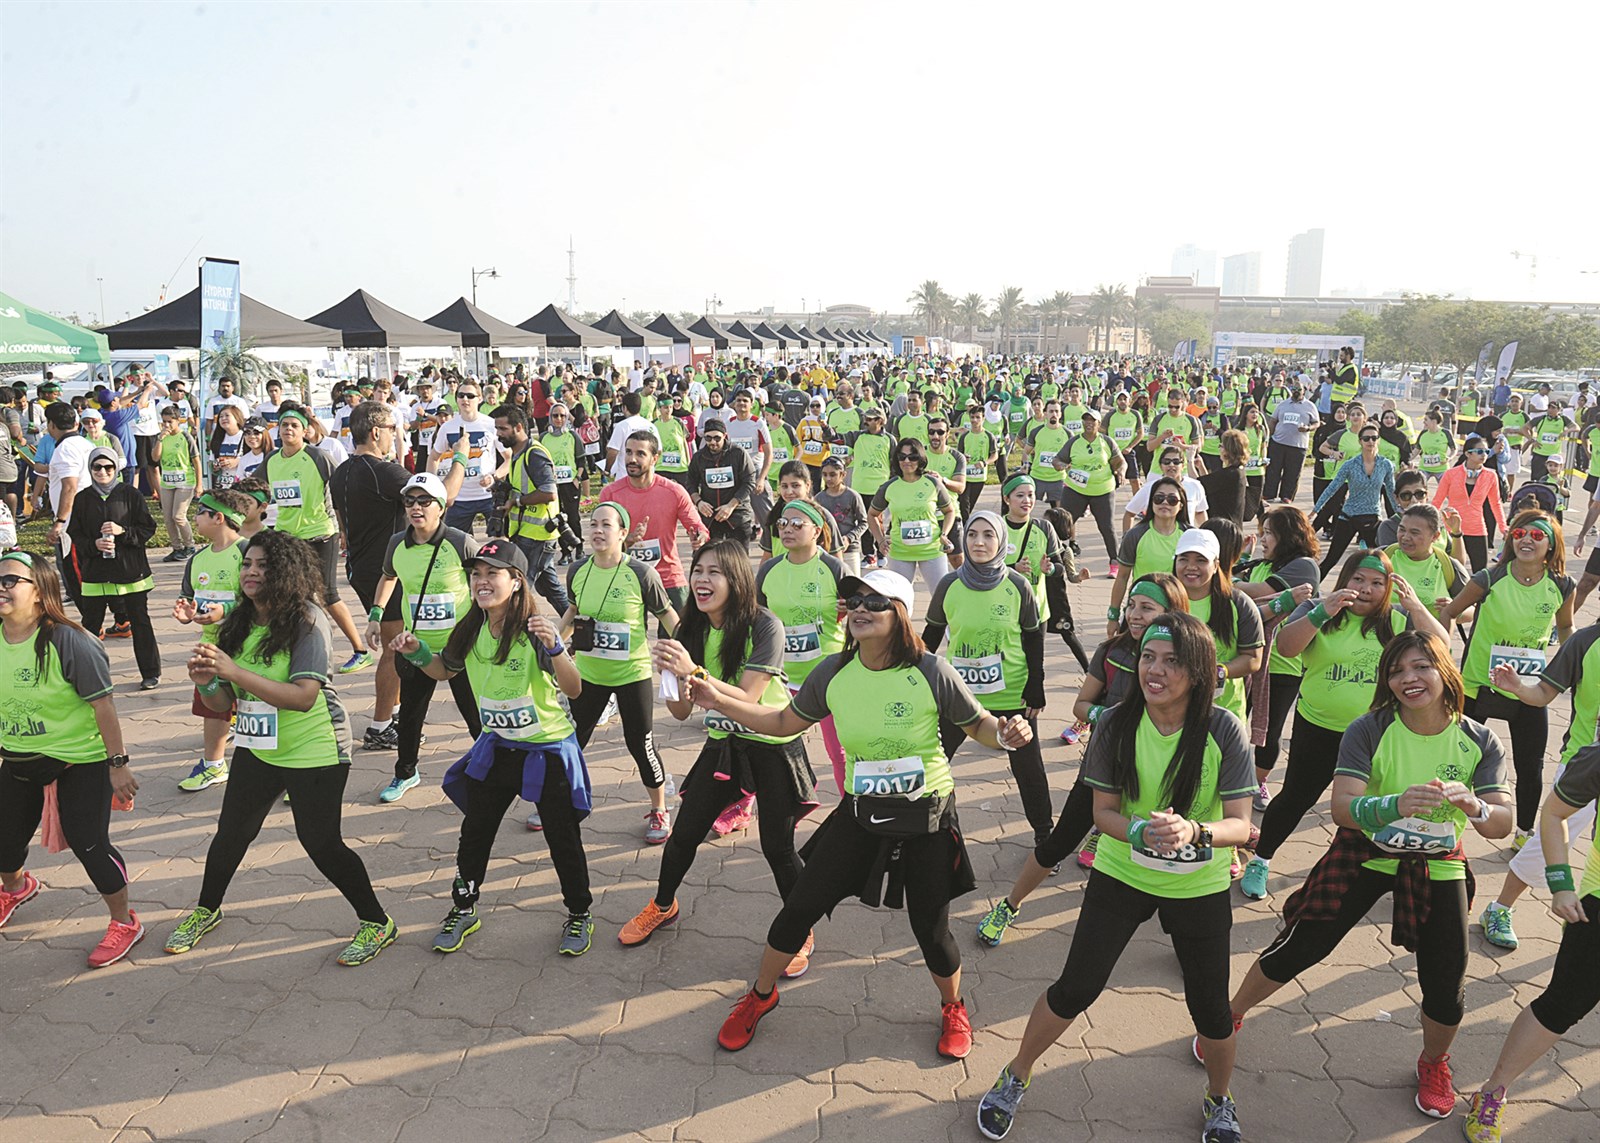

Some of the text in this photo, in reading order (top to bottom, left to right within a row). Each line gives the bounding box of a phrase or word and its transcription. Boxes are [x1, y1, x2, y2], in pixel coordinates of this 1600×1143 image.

[204, 284, 233, 298] HYDRATE
[8, 343, 53, 354] coconut
[53, 345, 82, 355] water
[711, 474, 728, 483] 925
[276, 488, 295, 499] 800
[907, 528, 928, 538] 425
[630, 549, 654, 561] 459
[417, 604, 447, 620] 435
[958, 666, 1000, 683] 2009
[237, 714, 270, 736] 2001
[483, 709, 532, 728] 2018
[862, 774, 918, 795] 2017
